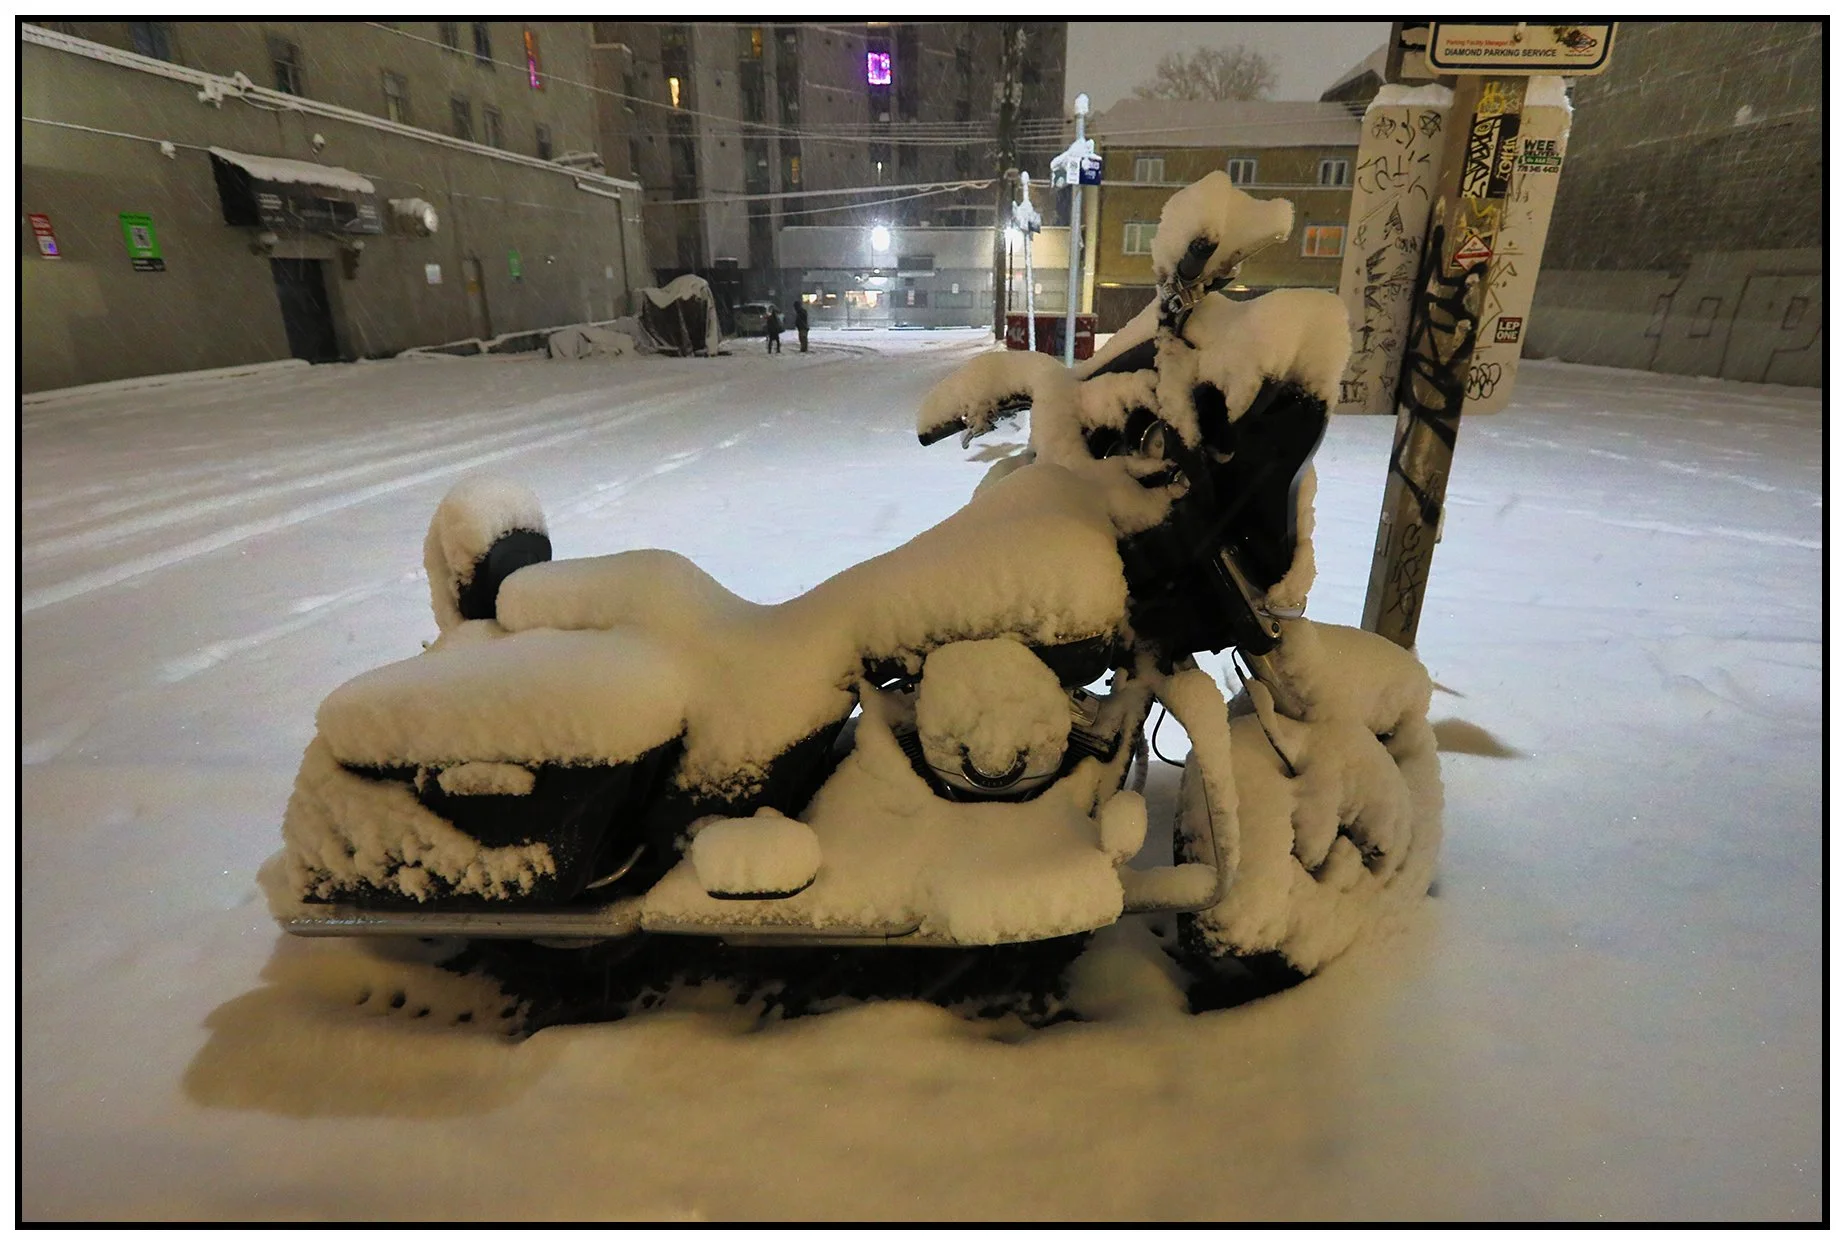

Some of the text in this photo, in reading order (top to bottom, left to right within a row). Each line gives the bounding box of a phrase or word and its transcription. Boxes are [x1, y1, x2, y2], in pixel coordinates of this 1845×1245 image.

[1446, 39, 1465, 47] Parking
[1444, 48, 1558, 57] DIAMOND PARKING SERVICE
[1525, 139, 1556, 150] WEE
[1498, 321, 1520, 331] LEP
[1496, 330, 1518, 340] ONE
